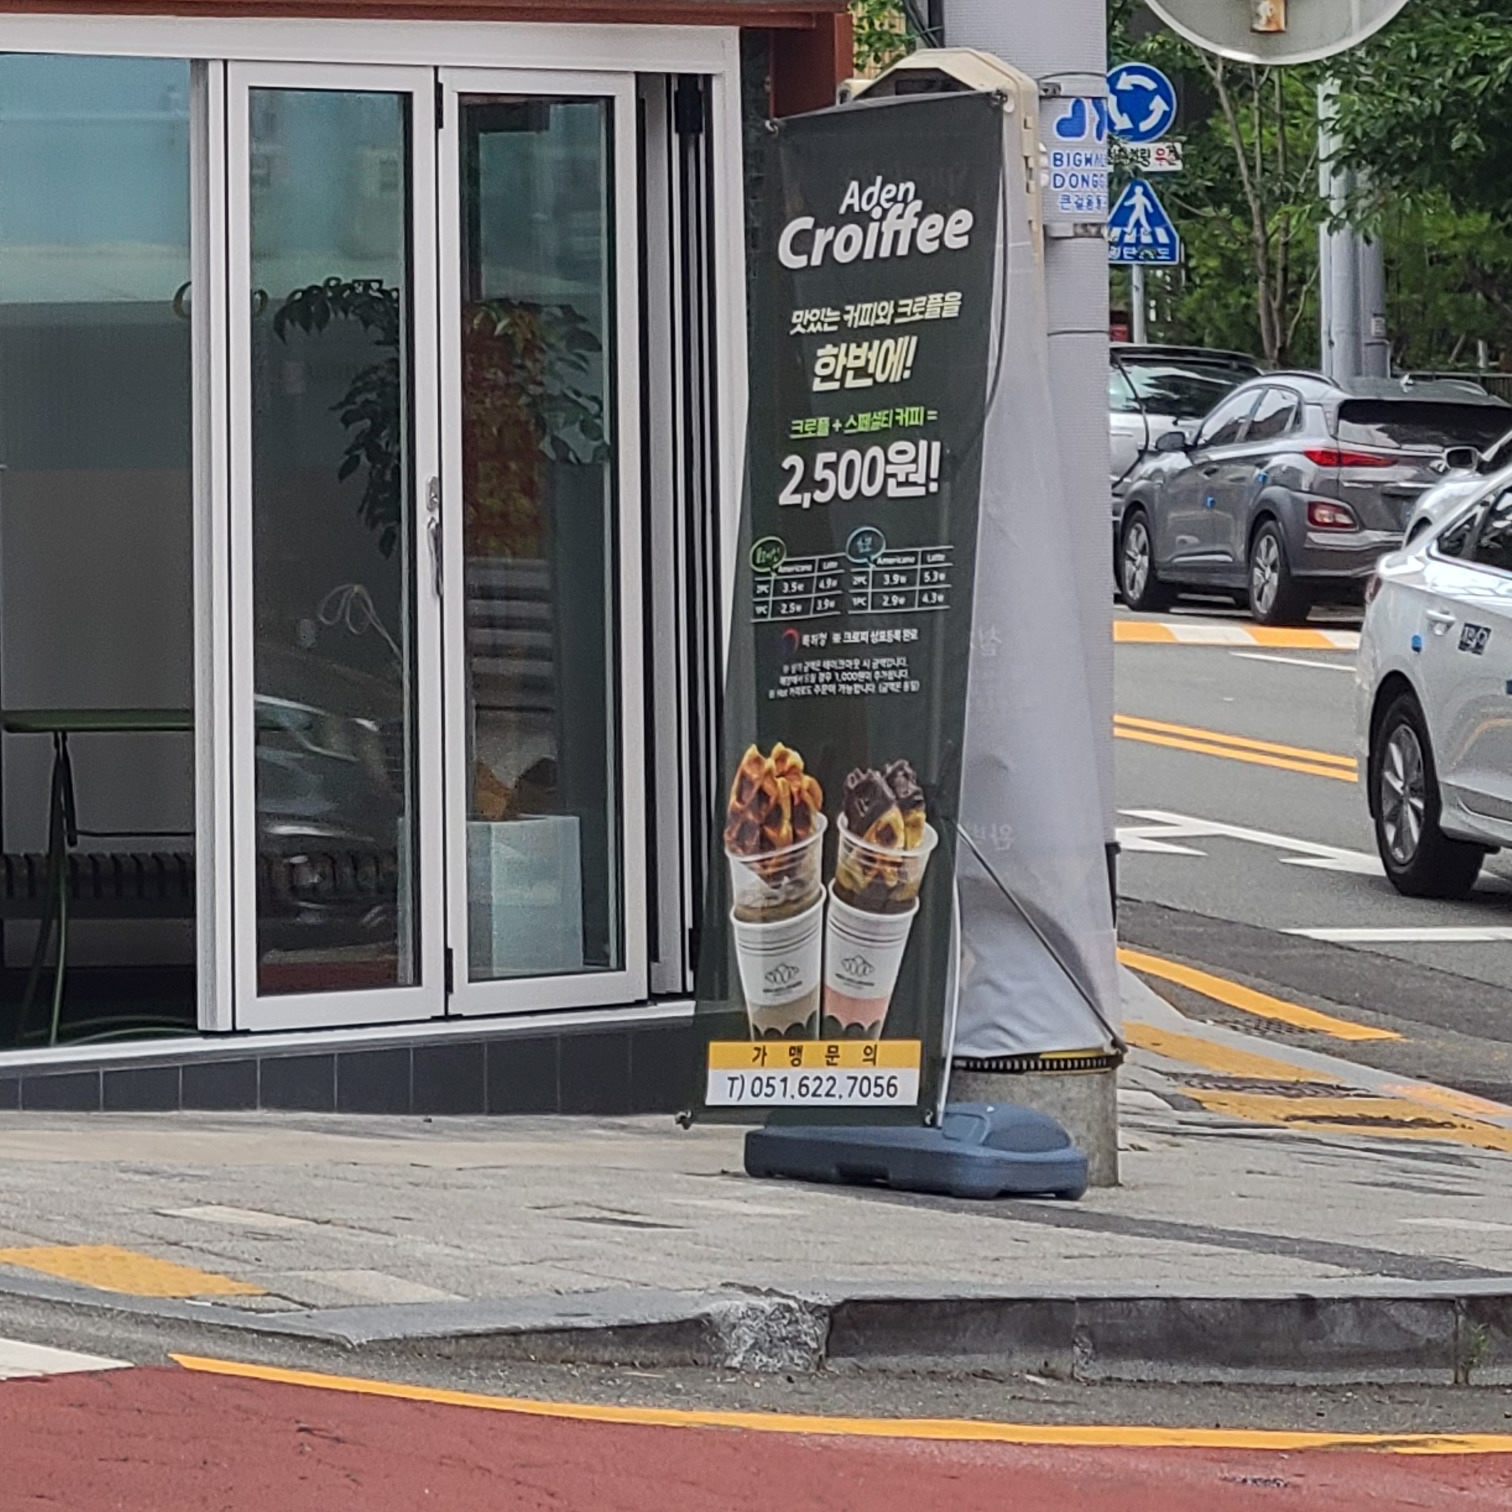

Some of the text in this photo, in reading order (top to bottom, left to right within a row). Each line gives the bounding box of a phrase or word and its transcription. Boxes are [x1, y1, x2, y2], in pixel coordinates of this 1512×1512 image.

[839, 175, 916, 215] Aden
[777, 198, 974, 269] Croiffee
[789, 291, 963, 335] 맛있는 커피와 크로플을
[812, 336, 918, 392] 한번에!
[895, 406, 925, 426] 커피
[778, 440, 941, 509] 2,500원!
